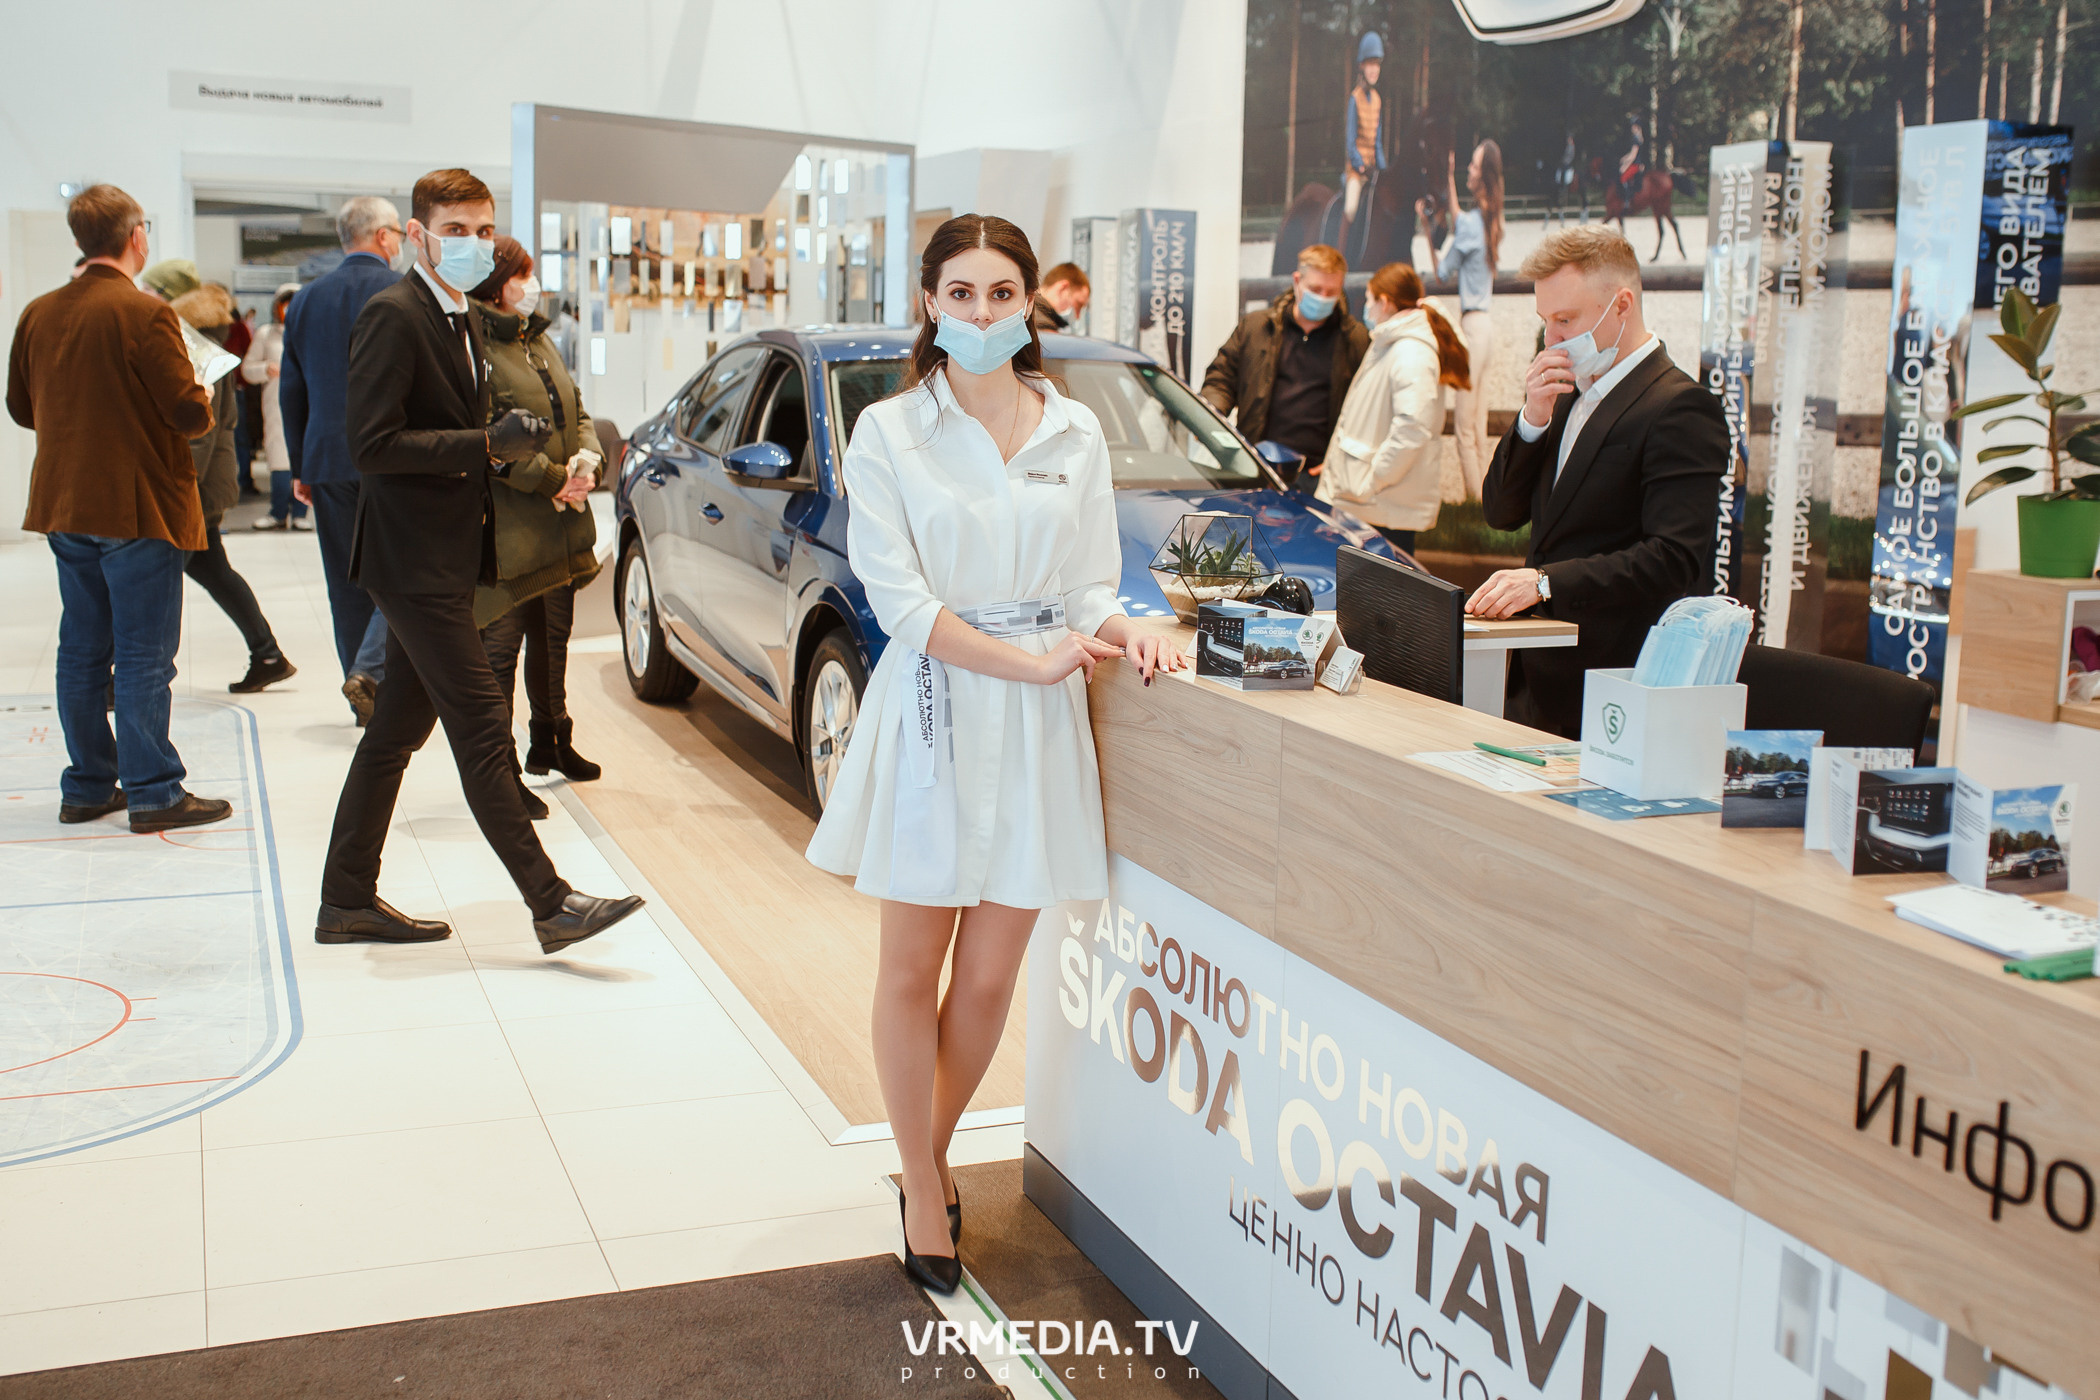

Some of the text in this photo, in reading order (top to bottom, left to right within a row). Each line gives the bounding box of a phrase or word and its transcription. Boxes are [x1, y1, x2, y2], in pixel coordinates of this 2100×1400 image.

[1783, 159, 1806, 224] ЗОН
[1806, 162, 1835, 270] ХОДОМ
[1999, 146, 2028, 236] ВИДА
[2020, 148, 2051, 304] ВАТЕЛЕМ
[1167, 221, 1187, 337] ДО 210 КМ/Ч
[1713, 321, 1743, 595] УЛЬТИМЕДИЙНЫЙ
[1893, 340, 1926, 509] БОЛЬШОЕ
[1884, 516, 1912, 636] САМОЕ
[1906, 450, 1943, 681] ОСТРАНСТВО
[1925, 421, 1946, 441] В
[916, 688, 929, 741] АБСОЛЮТНО
[1608, 709, 1619, 735] Š
[1058, 911, 1254, 1166] ŠKODA
[1094, 898, 1550, 1246] АБСОЛЮТНО НОВАЯ
[1855, 1049, 2096, 1234] Инфо
[1229, 1175, 1510, 1400] ЦЕННО НАСТО
